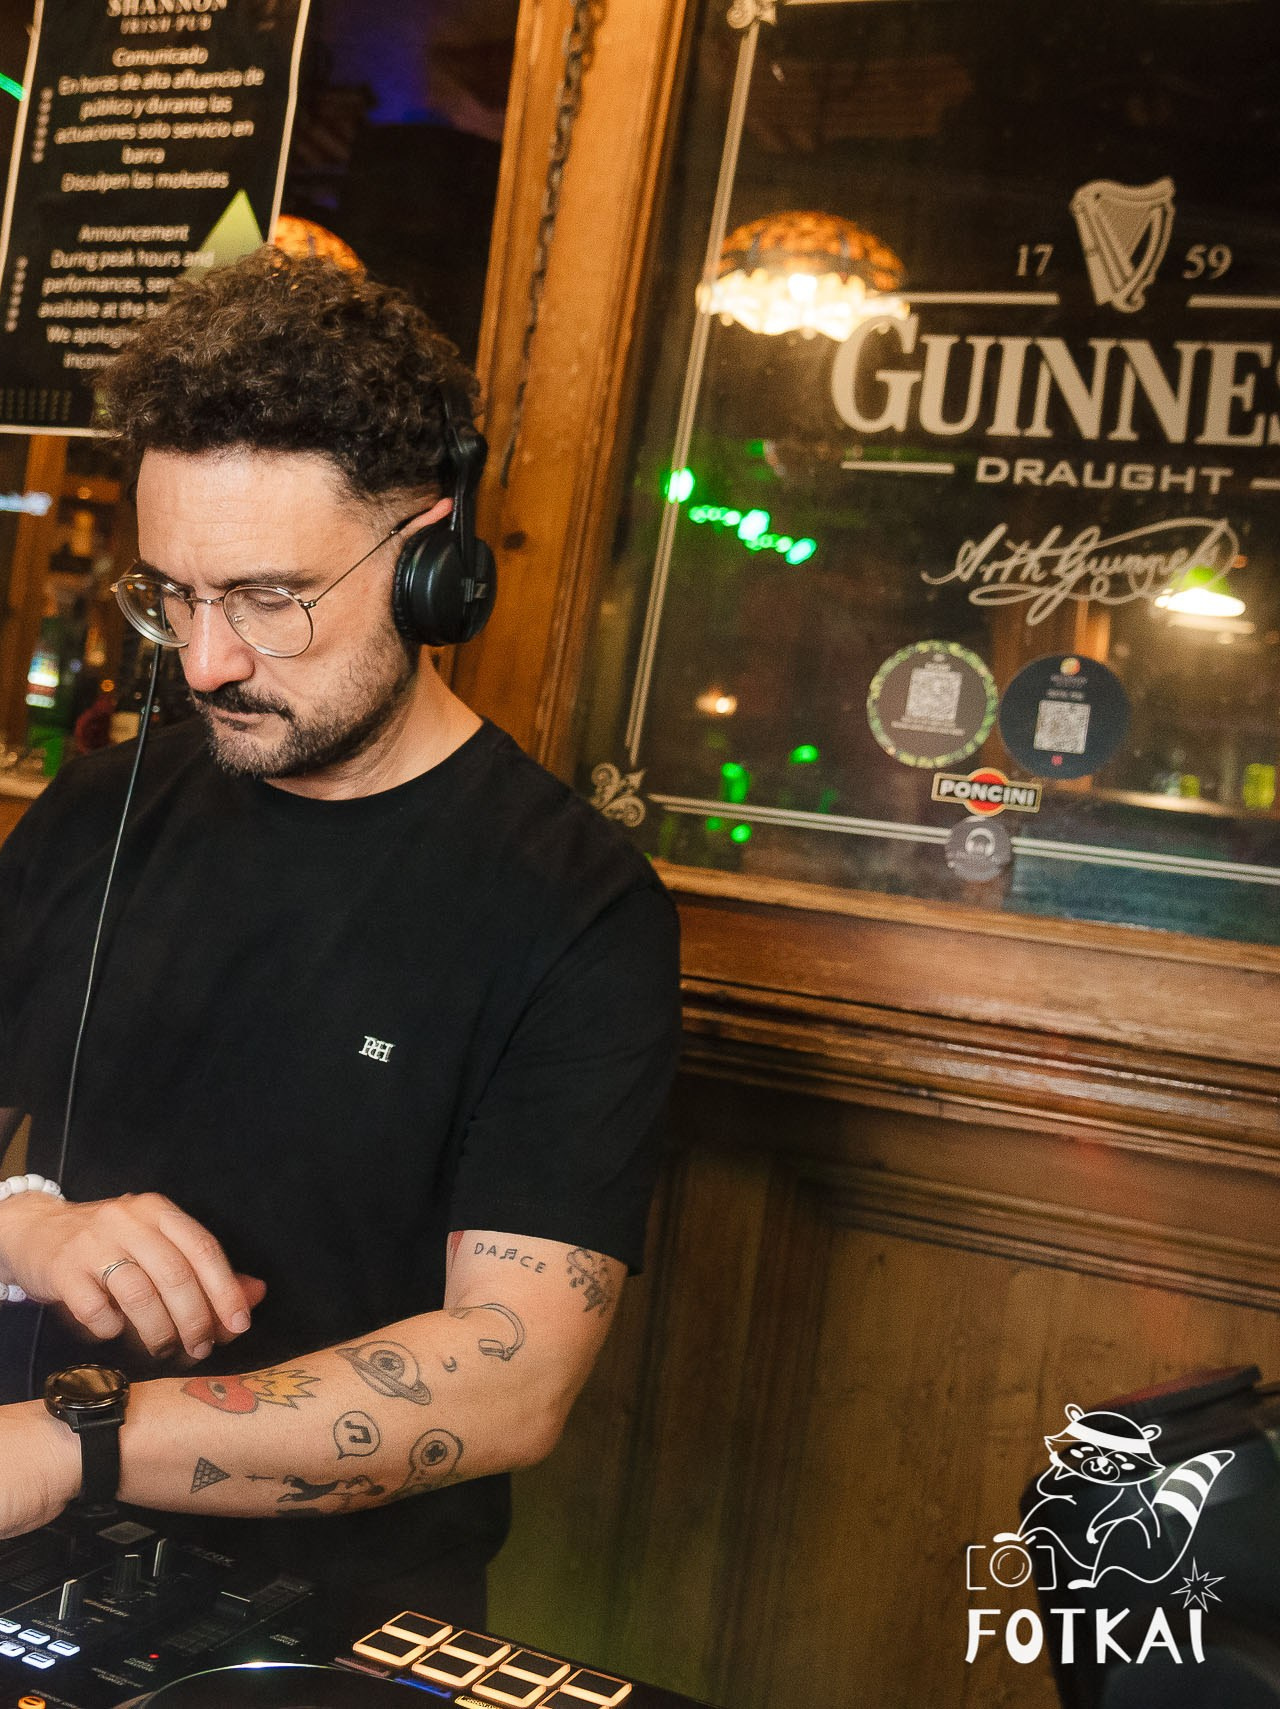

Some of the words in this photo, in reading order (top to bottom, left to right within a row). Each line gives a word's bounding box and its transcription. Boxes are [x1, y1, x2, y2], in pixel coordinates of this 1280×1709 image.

[112, 45, 209, 67] Comunicado
[58, 75, 79, 96] En
[79, 75, 119, 94] horas
[120, 71, 141, 91] de
[142, 71, 171, 90] alta
[172, 68, 243, 89] afluencia
[243, 66, 265, 86] de
[132, 99, 146, 118] y
[145, 94, 208, 115] durante
[209, 92, 233, 113] las
[54, 123, 136, 144] actuaciones
[171, 119, 231, 139] servicio
[232, 120, 255, 137] en
[121, 145, 166, 165] barra
[61, 171, 130, 194] Disculpen
[131, 170, 154, 189] las
[155, 170, 230, 189] molestias
[78, 224, 191, 243] Announcement
[51, 249, 99, 272] During
[99, 249, 135, 270] peak
[136, 249, 181, 268] hours
[182, 250, 215, 268] and
[1015, 243, 1053, 279] 17
[1182, 244, 1233, 280] 59
[37, 299, 100, 319] available
[101, 301, 118, 318] at
[119, 300, 145, 318] the
[46, 323, 72, 344] We
[831, 312, 1280, 448] GUINNE
[975, 456, 1234, 495] DRAUGHT
[938, 779, 1036, 806] PONCINI
